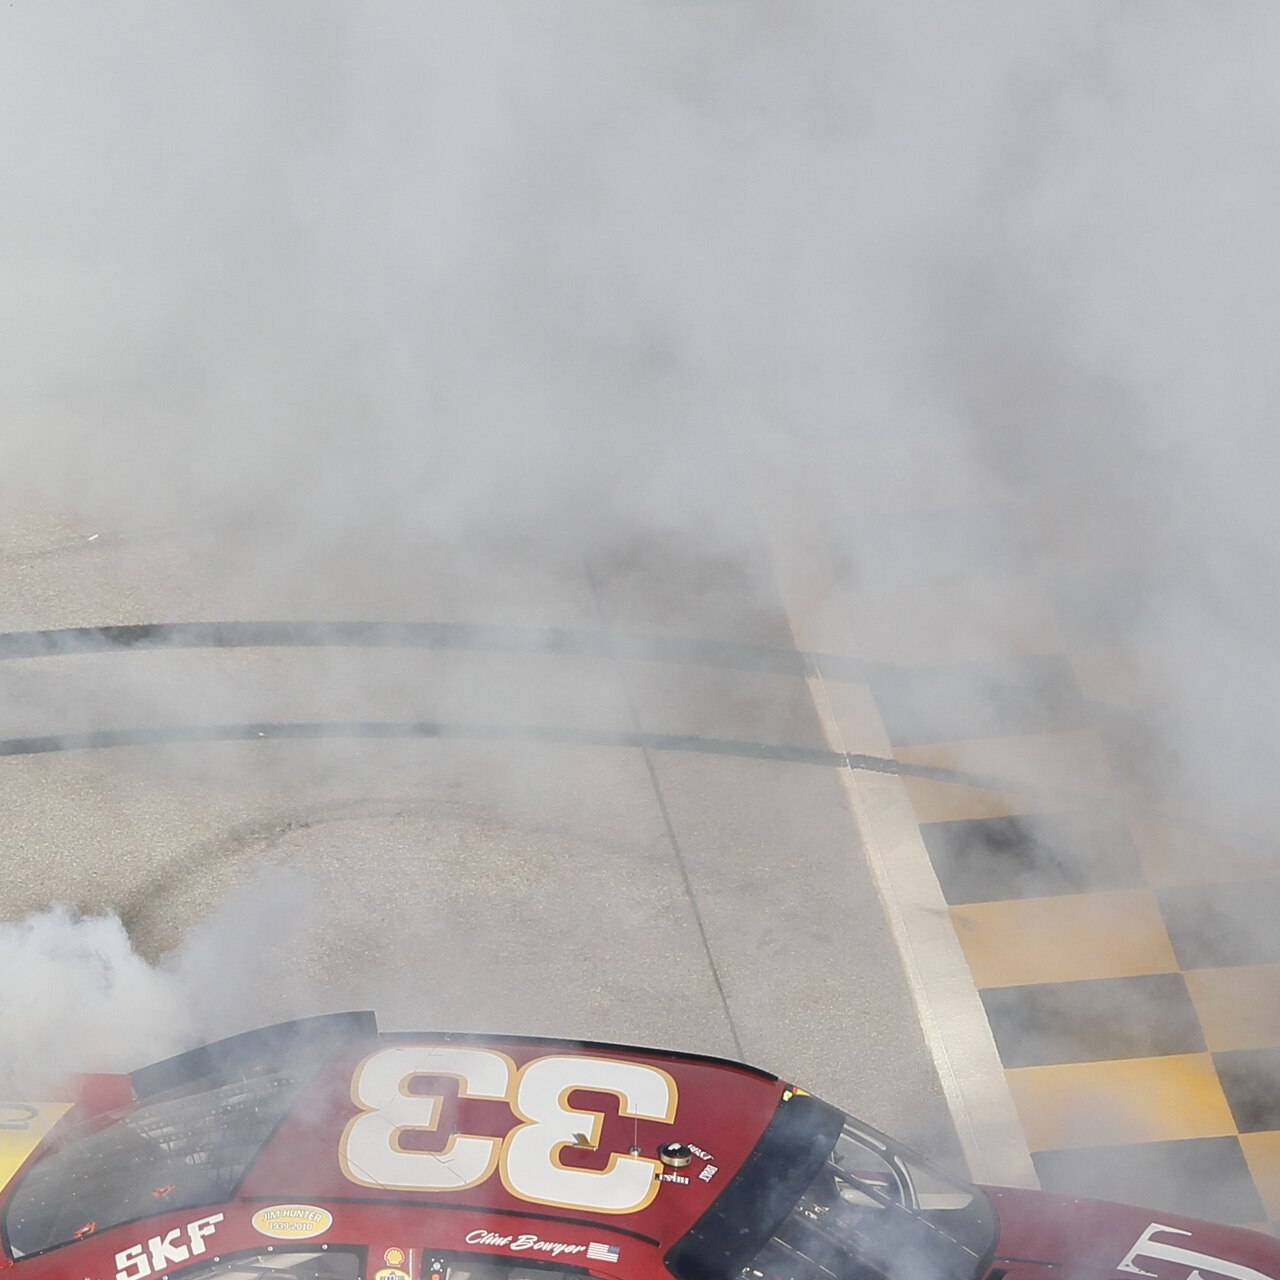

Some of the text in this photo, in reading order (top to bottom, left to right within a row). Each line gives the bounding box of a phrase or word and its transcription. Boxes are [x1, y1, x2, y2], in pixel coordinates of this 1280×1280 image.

[337, 1046, 679, 1214] 33
[263, 1210, 323, 1222] JIM HUNTER
[464, 1229, 587, 1257] Clint Bowyer
